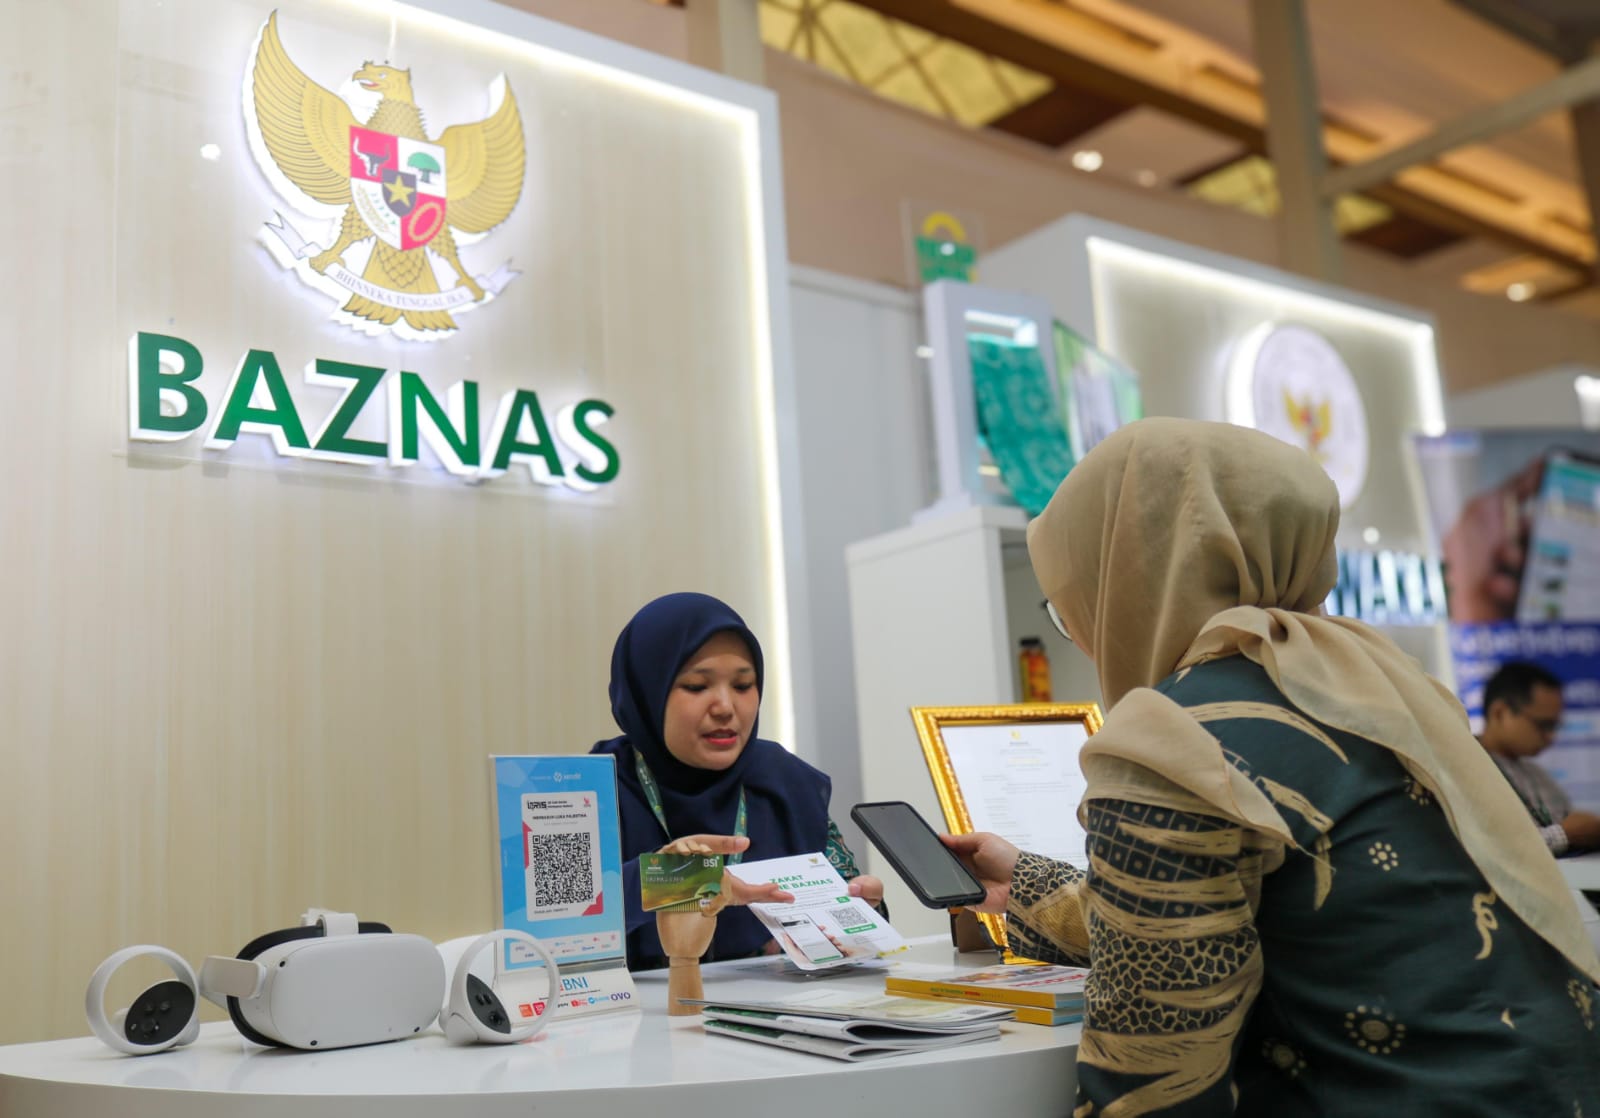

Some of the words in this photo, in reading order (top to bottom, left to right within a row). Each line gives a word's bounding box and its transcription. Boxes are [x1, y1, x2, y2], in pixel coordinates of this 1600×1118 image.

[133, 331, 620, 487] BAZNAS
[769, 874, 803, 884] ZAKAT
[791, 878, 834, 889] BAZNAS
[562, 976, 589, 991] BNI
[610, 991, 631, 1001] OVO
